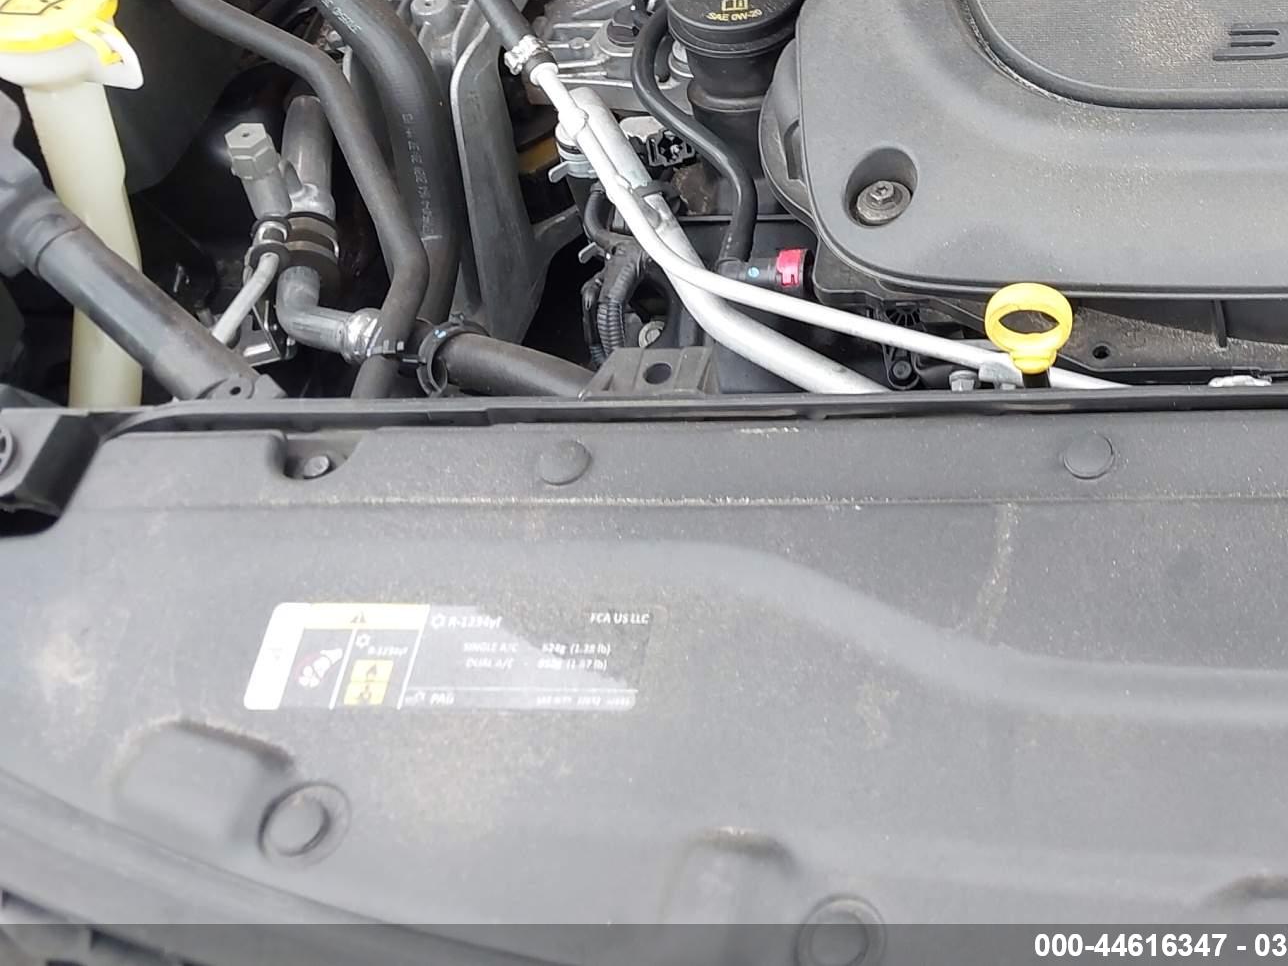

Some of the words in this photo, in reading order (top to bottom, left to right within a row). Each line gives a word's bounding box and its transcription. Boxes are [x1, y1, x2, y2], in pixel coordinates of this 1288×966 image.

[706, 12, 730, 22] SAE
[731, 9, 763, 22] 0W-20
[590, 612, 611, 625] FCA
[613, 613, 629, 625] US
[630, 613, 650, 625] LLC
[597, 643, 611, 656] lb)
